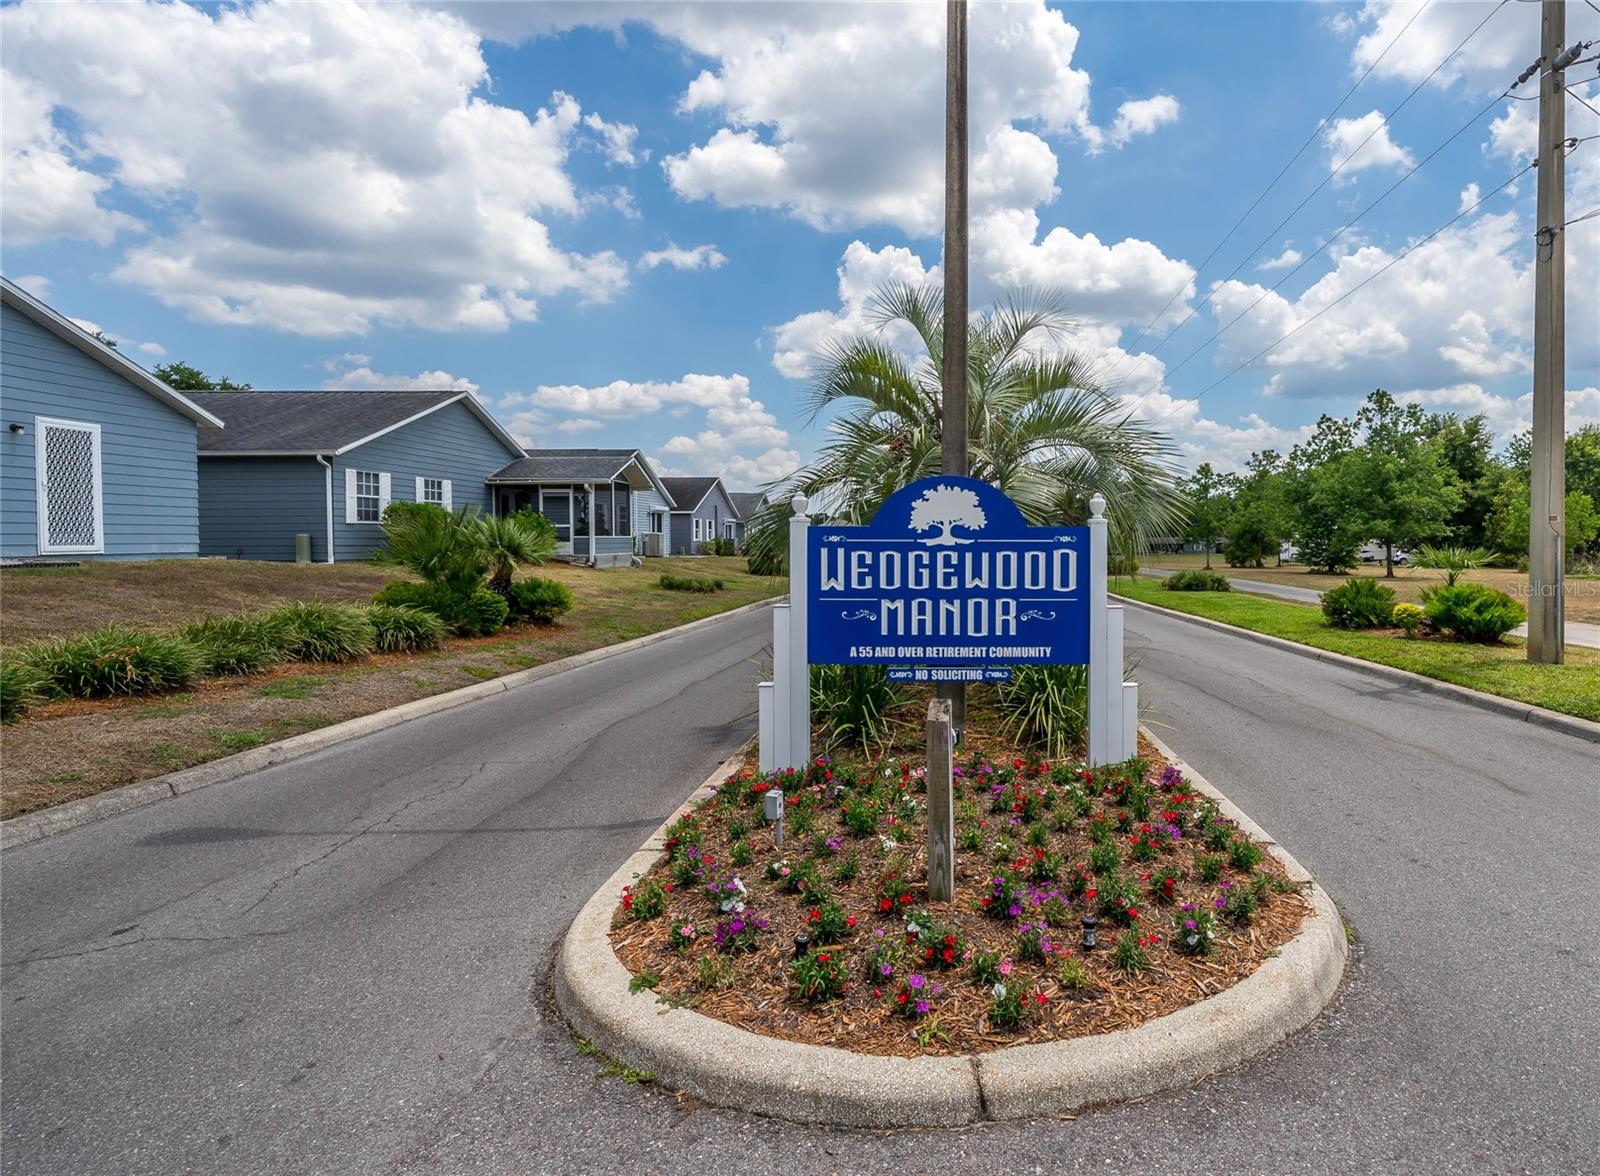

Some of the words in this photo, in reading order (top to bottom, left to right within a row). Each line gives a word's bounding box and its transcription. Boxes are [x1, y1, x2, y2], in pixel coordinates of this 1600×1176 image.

[820, 547, 1078, 592] WEDGEWOOD
[881, 598, 1017, 637] MANOR
[849, 646, 857, 658] A
[859, 646, 873, 658] 55
[874, 646, 896, 658] AND
[897, 646, 924, 658] OVER
[925, 646, 987, 658] RETIREMENT
[989, 646, 1052, 658] COMMUNITY
[915, 669, 928, 681] NO
[931, 669, 983, 681] SOLICITING
